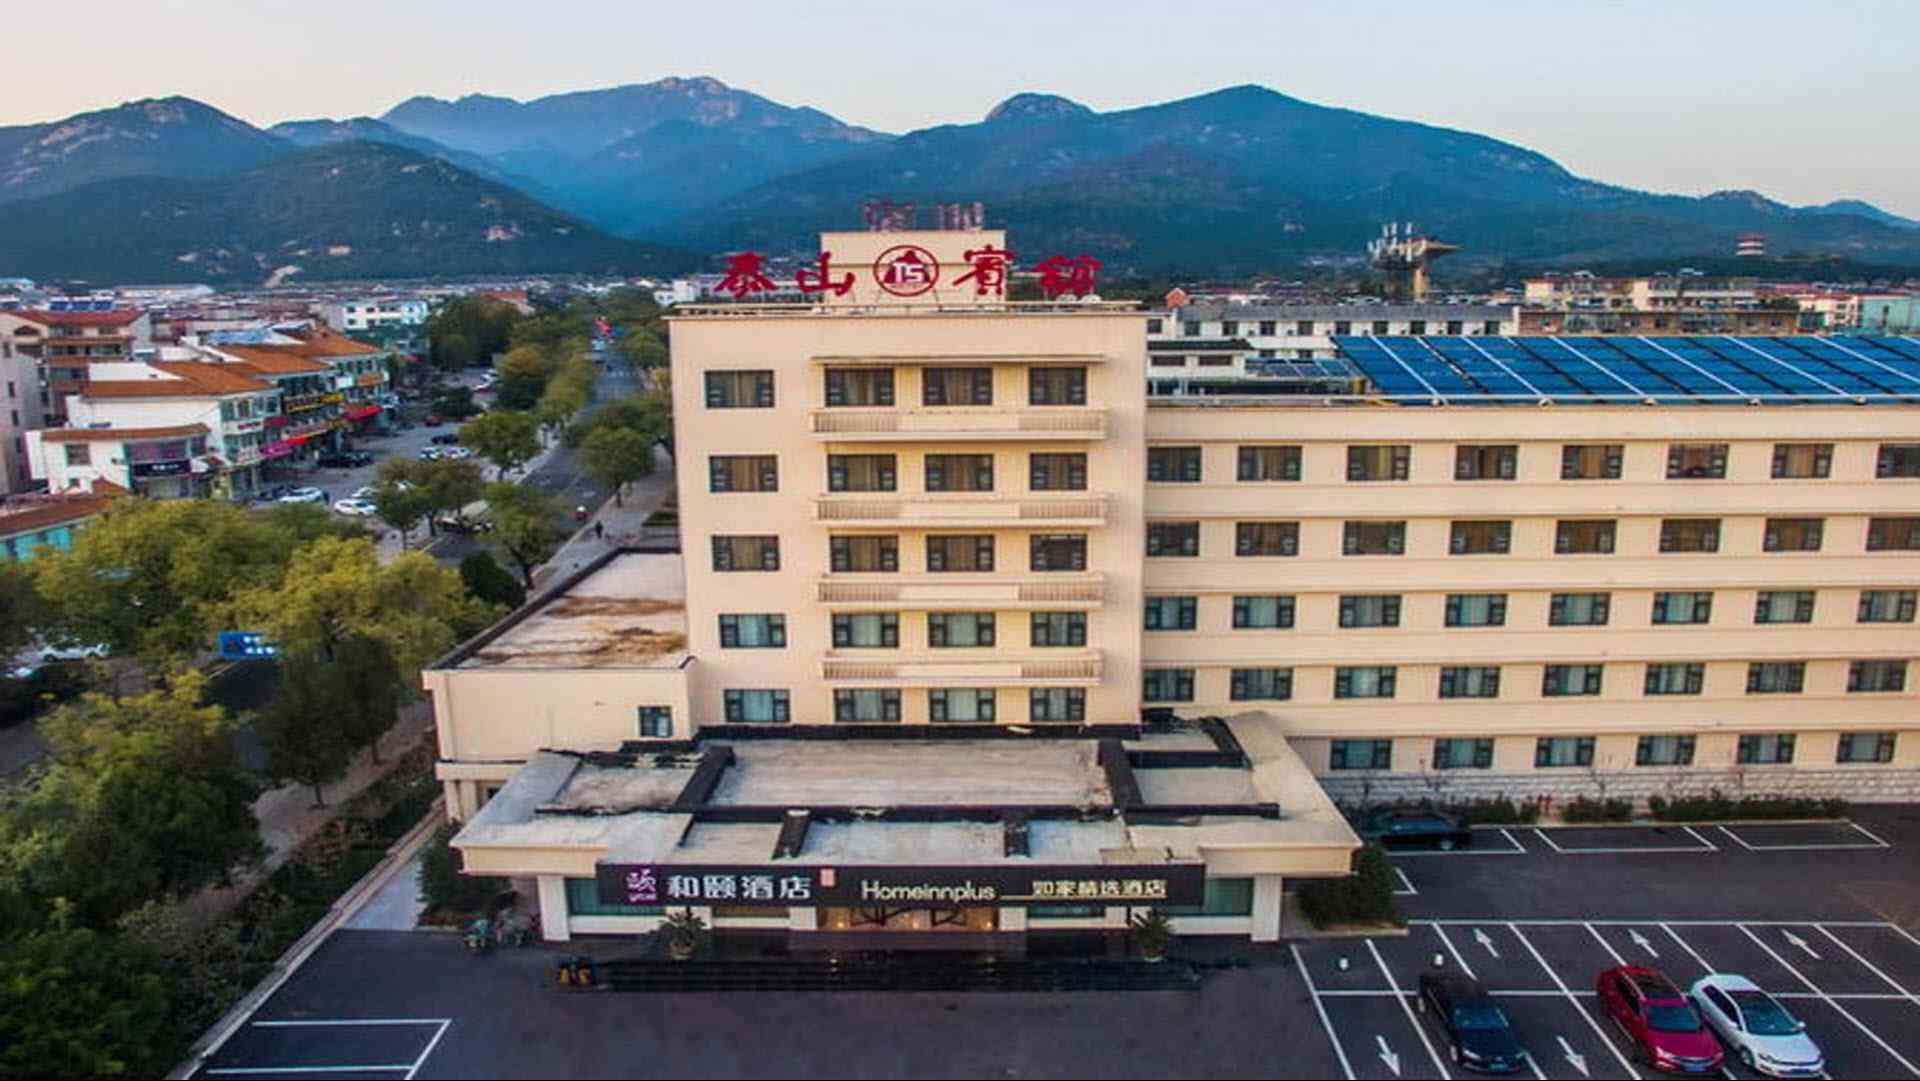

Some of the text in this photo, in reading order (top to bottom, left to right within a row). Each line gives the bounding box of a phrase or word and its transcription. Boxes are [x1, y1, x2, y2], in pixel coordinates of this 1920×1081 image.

[714, 251, 856, 298] 泰山
[667, 874, 812, 900] 和颐酒店
[860, 880, 996, 903] Homeinnplus
